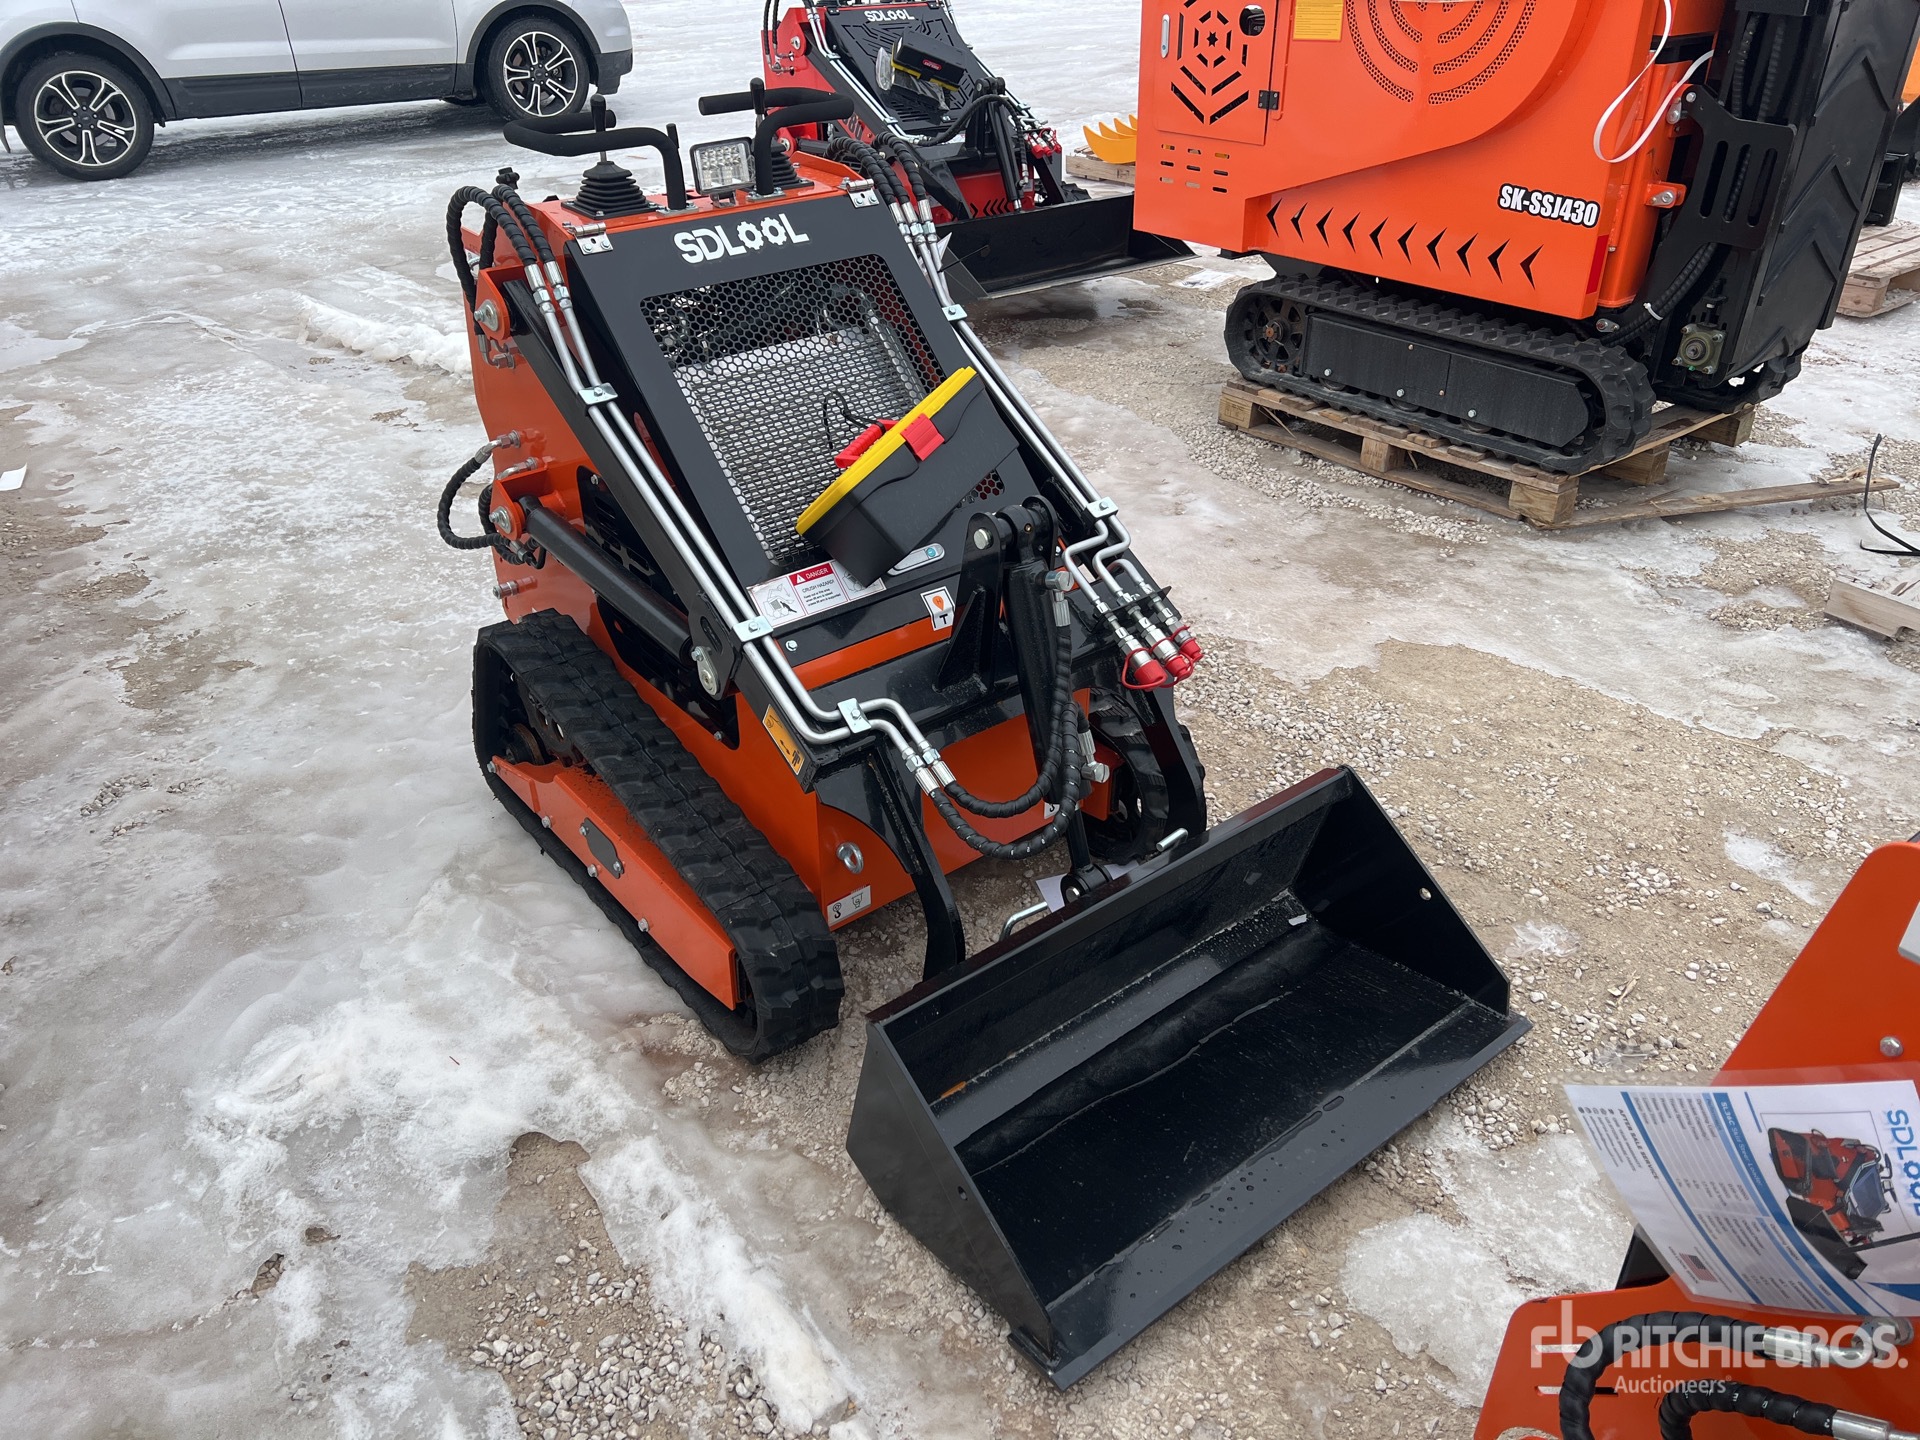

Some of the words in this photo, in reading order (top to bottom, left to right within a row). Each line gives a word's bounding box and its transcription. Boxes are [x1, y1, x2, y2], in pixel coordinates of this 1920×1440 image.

[864, 8, 916, 22] SDLOOL
[1499, 184, 1599, 227] SK-SSJ430
[674, 213, 810, 264] SDLOOL
[806, 568, 828, 579] DANGER
[939, 613, 948, 624] T
